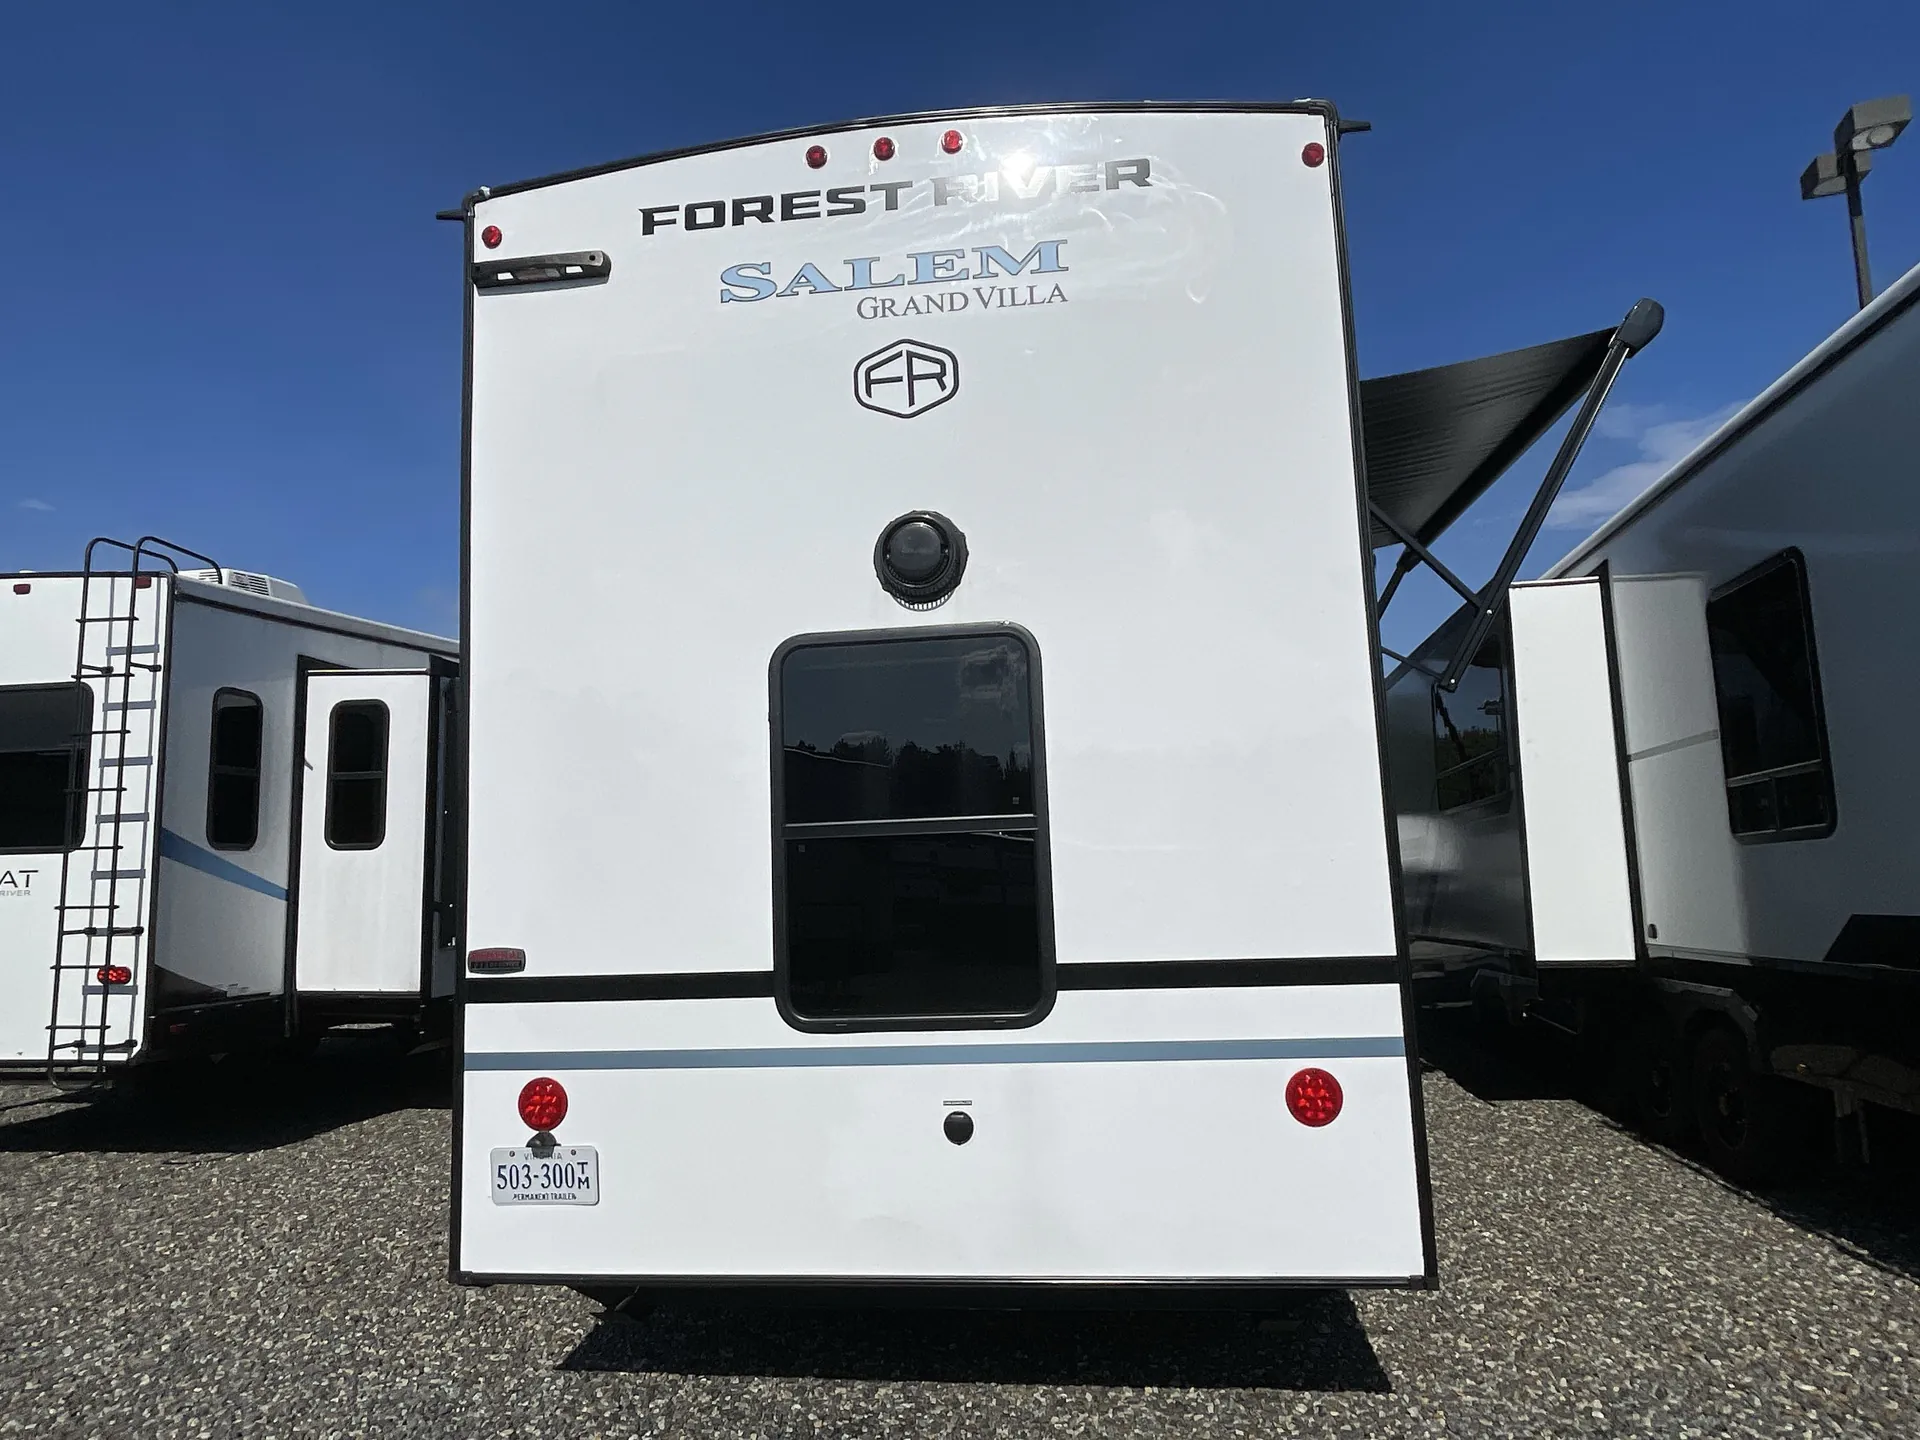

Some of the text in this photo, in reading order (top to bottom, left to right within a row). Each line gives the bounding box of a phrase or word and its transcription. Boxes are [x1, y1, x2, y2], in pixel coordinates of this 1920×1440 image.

[638, 157, 1153, 236] FOREST RIVER
[720, 239, 1069, 304] SALEM
[856, 282, 1069, 320] GRAND VILLA
[496, 1162, 575, 1190] 503-300
